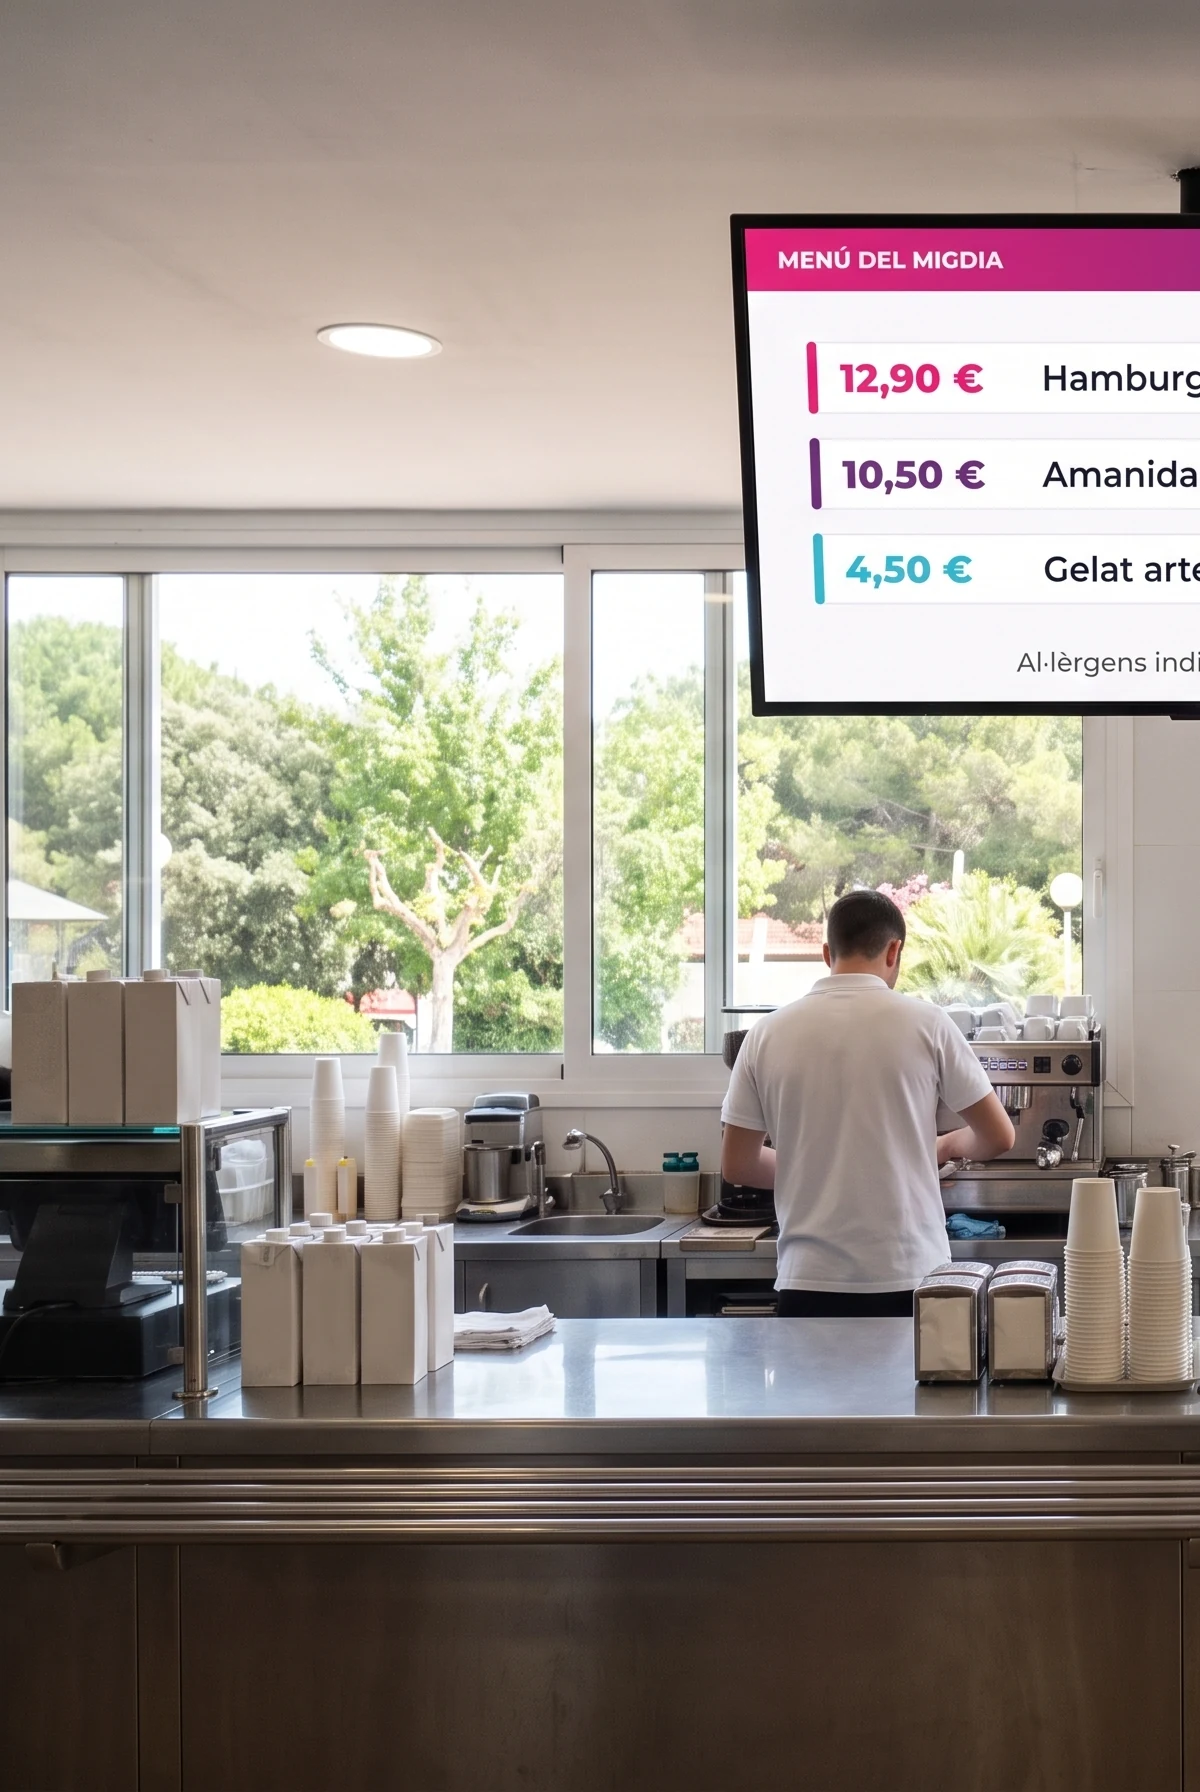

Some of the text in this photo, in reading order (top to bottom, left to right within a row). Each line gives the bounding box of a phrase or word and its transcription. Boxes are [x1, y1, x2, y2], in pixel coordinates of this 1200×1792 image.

[778, 246, 1004, 269] MENÚ DEL MIGDIA
[840, 364, 940, 399] 12,90
[954, 364, 983, 393] €
[842, 459, 942, 495] 10,50
[956, 459, 985, 489] €
[1043, 458, 1197, 488] Amanida
[845, 554, 931, 589] 4,50
[943, 554, 972, 584] €
[1044, 555, 1134, 583] Gelat
[1017, 651, 1147, 677] Al·lèrgens
